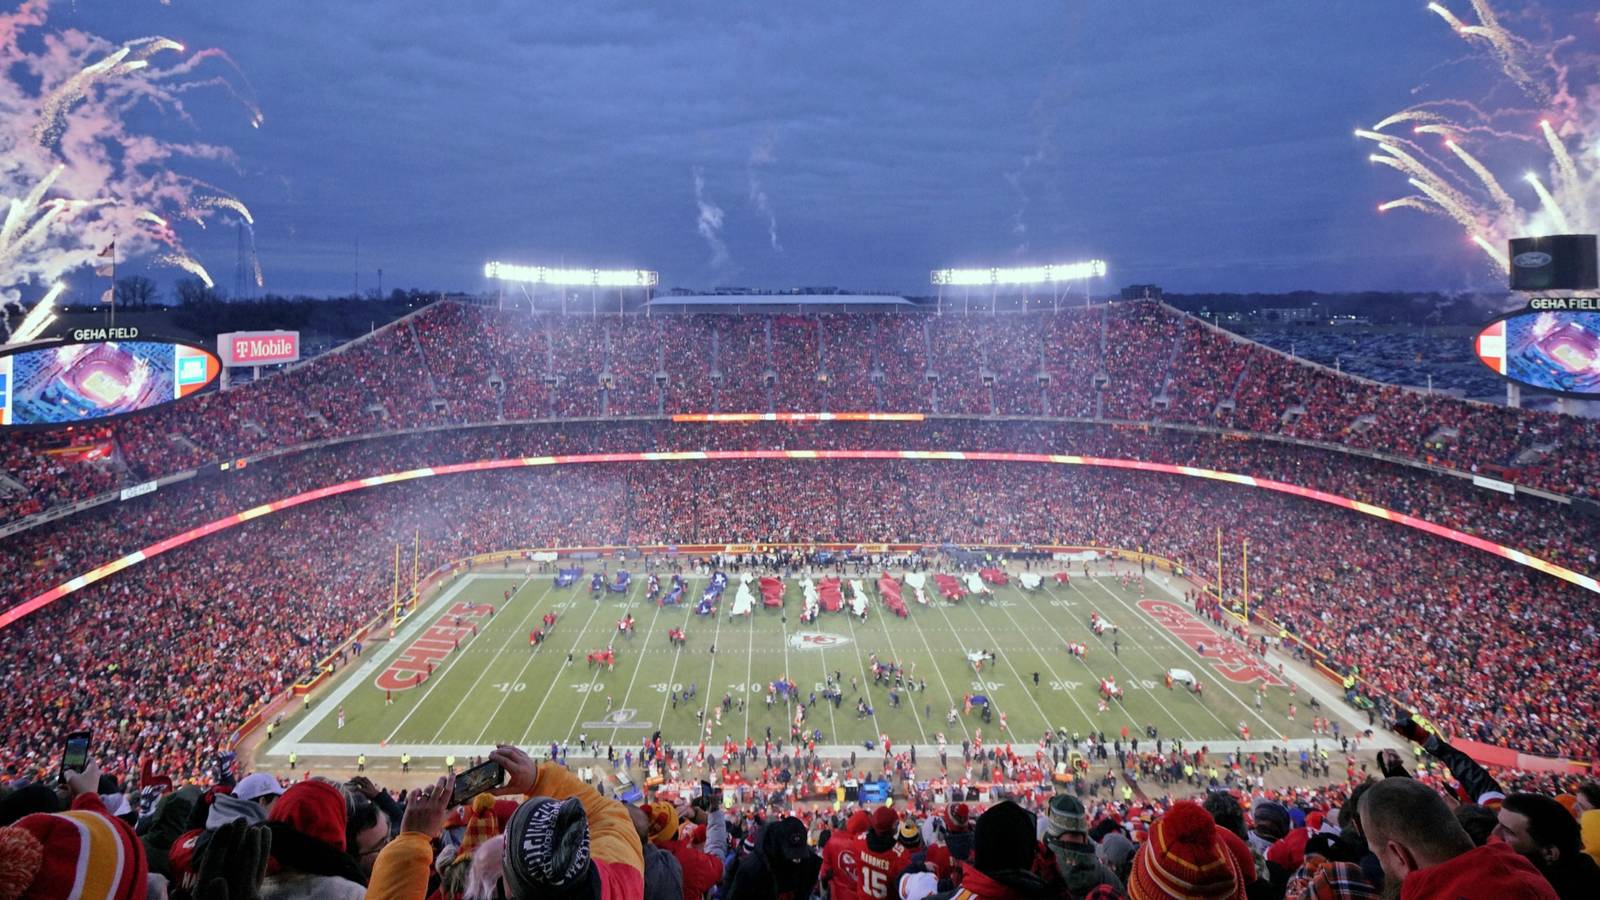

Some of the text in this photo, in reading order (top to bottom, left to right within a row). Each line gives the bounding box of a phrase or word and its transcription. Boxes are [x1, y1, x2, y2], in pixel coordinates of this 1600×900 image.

[1530, 298, 1567, 310] GEHA
[74, 327, 139, 341] GEHA FIELD
[250, 339, 292, 357] Mobile
[374, 601, 496, 692] CHIEFS
[860, 850, 890, 871] MAHOMES
[861, 866, 888, 899] 15
